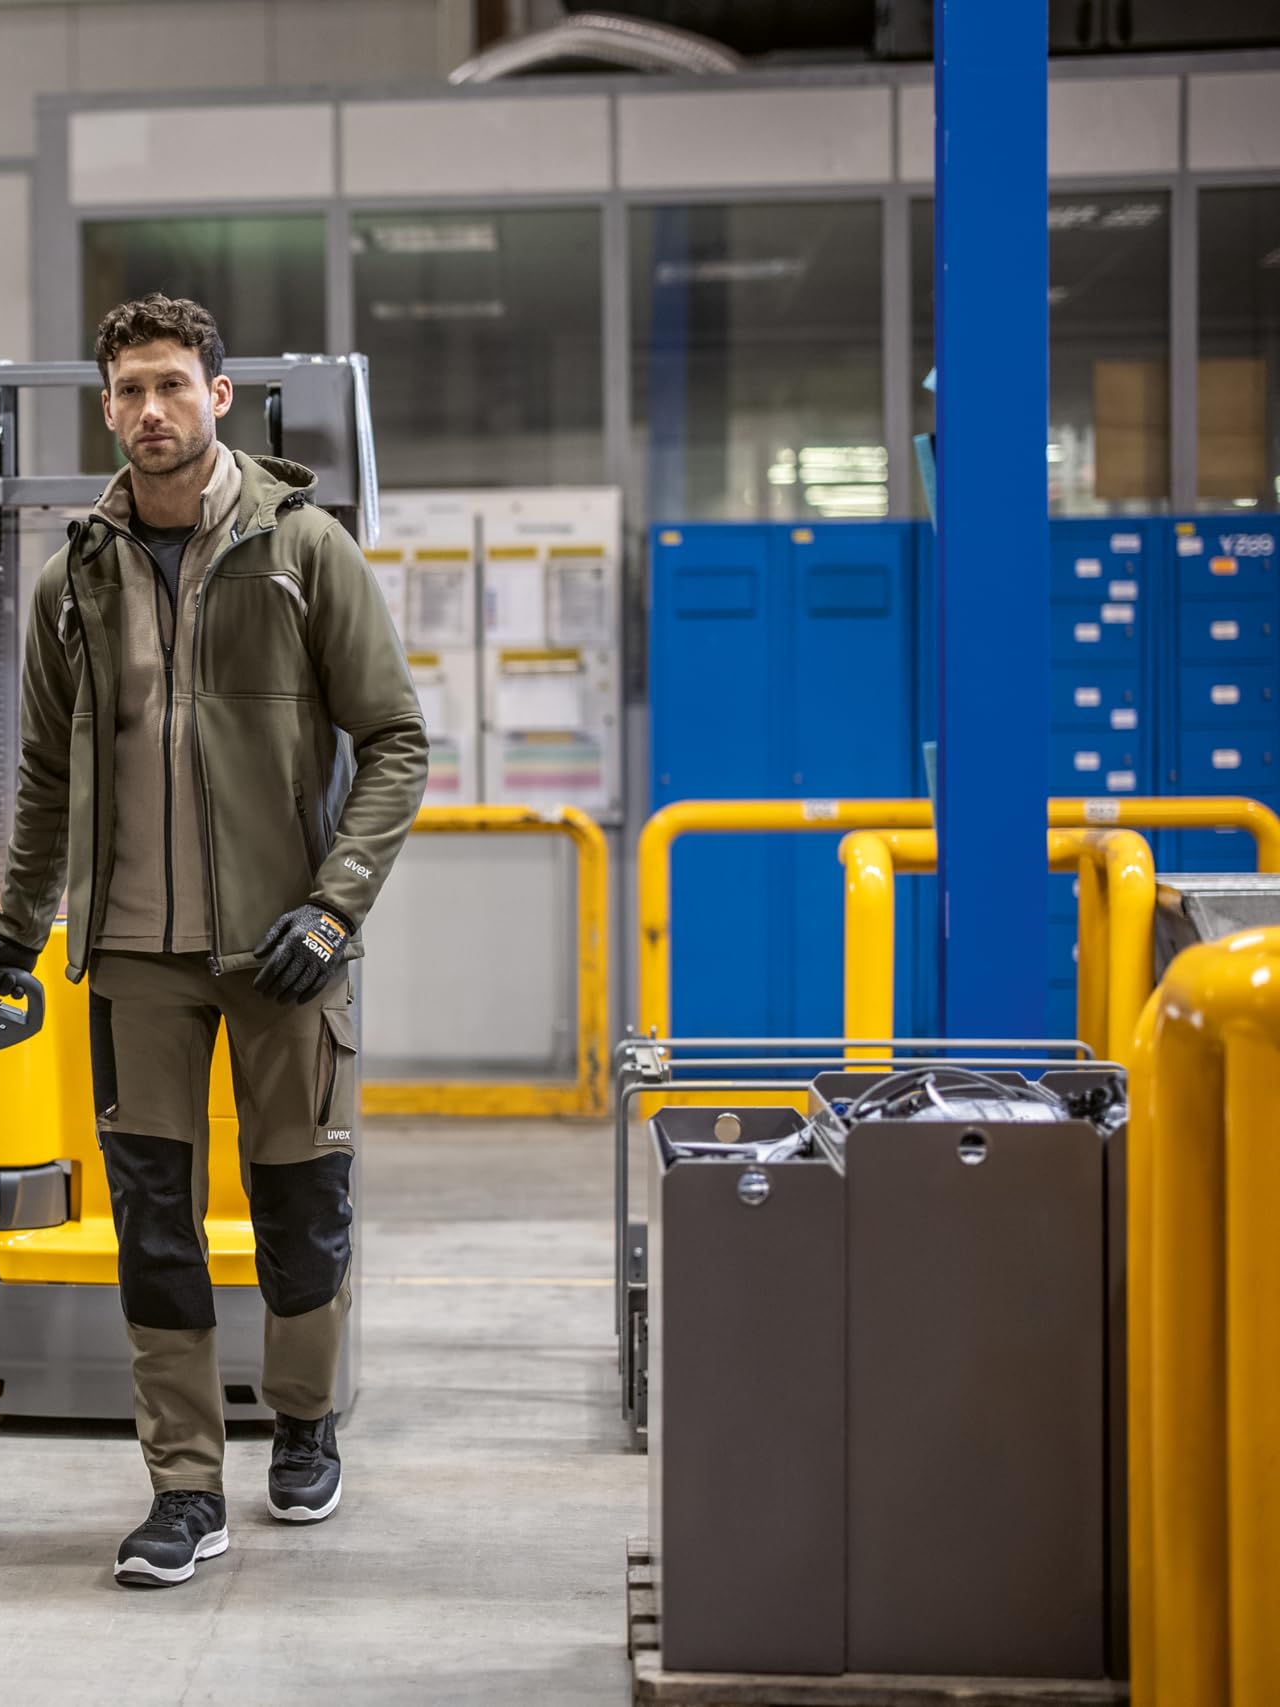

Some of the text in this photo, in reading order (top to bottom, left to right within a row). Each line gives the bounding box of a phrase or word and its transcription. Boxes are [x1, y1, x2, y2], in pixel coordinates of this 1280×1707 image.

[344, 857, 373, 880] uvex
[302, 935, 331, 963] uvex
[327, 1130, 351, 1140] uvex
